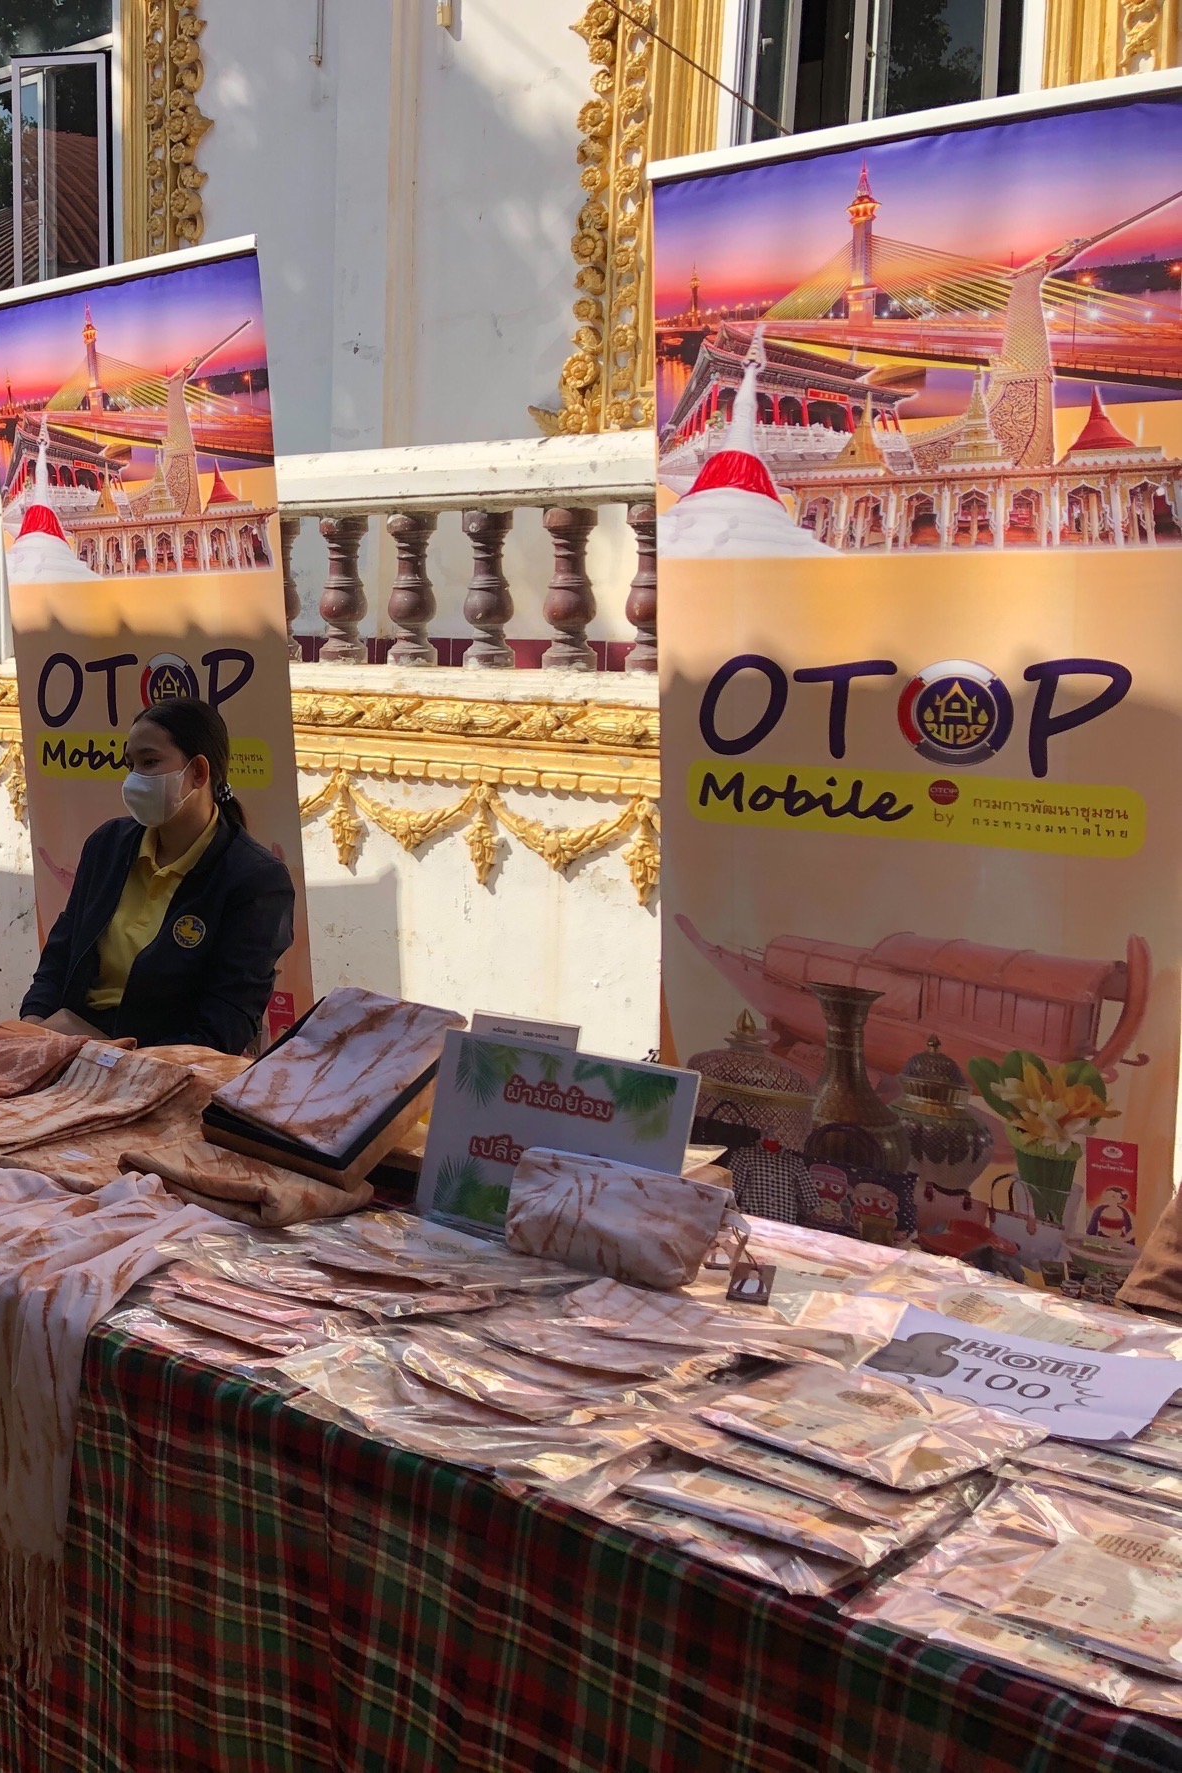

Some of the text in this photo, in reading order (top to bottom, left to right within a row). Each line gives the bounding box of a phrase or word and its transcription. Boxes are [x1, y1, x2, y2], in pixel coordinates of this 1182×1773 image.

[699, 653, 1133, 779] OTOP
[42, 738, 131, 771] Mobil
[698, 771, 915, 822] Mobile
[973, 798, 1129, 822] กรมการพัฒนาชุมชน
[933, 808, 955, 828] by
[972, 816, 1128, 838] กระทรวงมหาดไทย
[505, 1077, 612, 1119] ผ้ามัดย้อม
[471, 1137, 522, 1163] เปลือ
[953, 1339, 1101, 1382] HOT!
[962, 1367, 1051, 1399] 100
